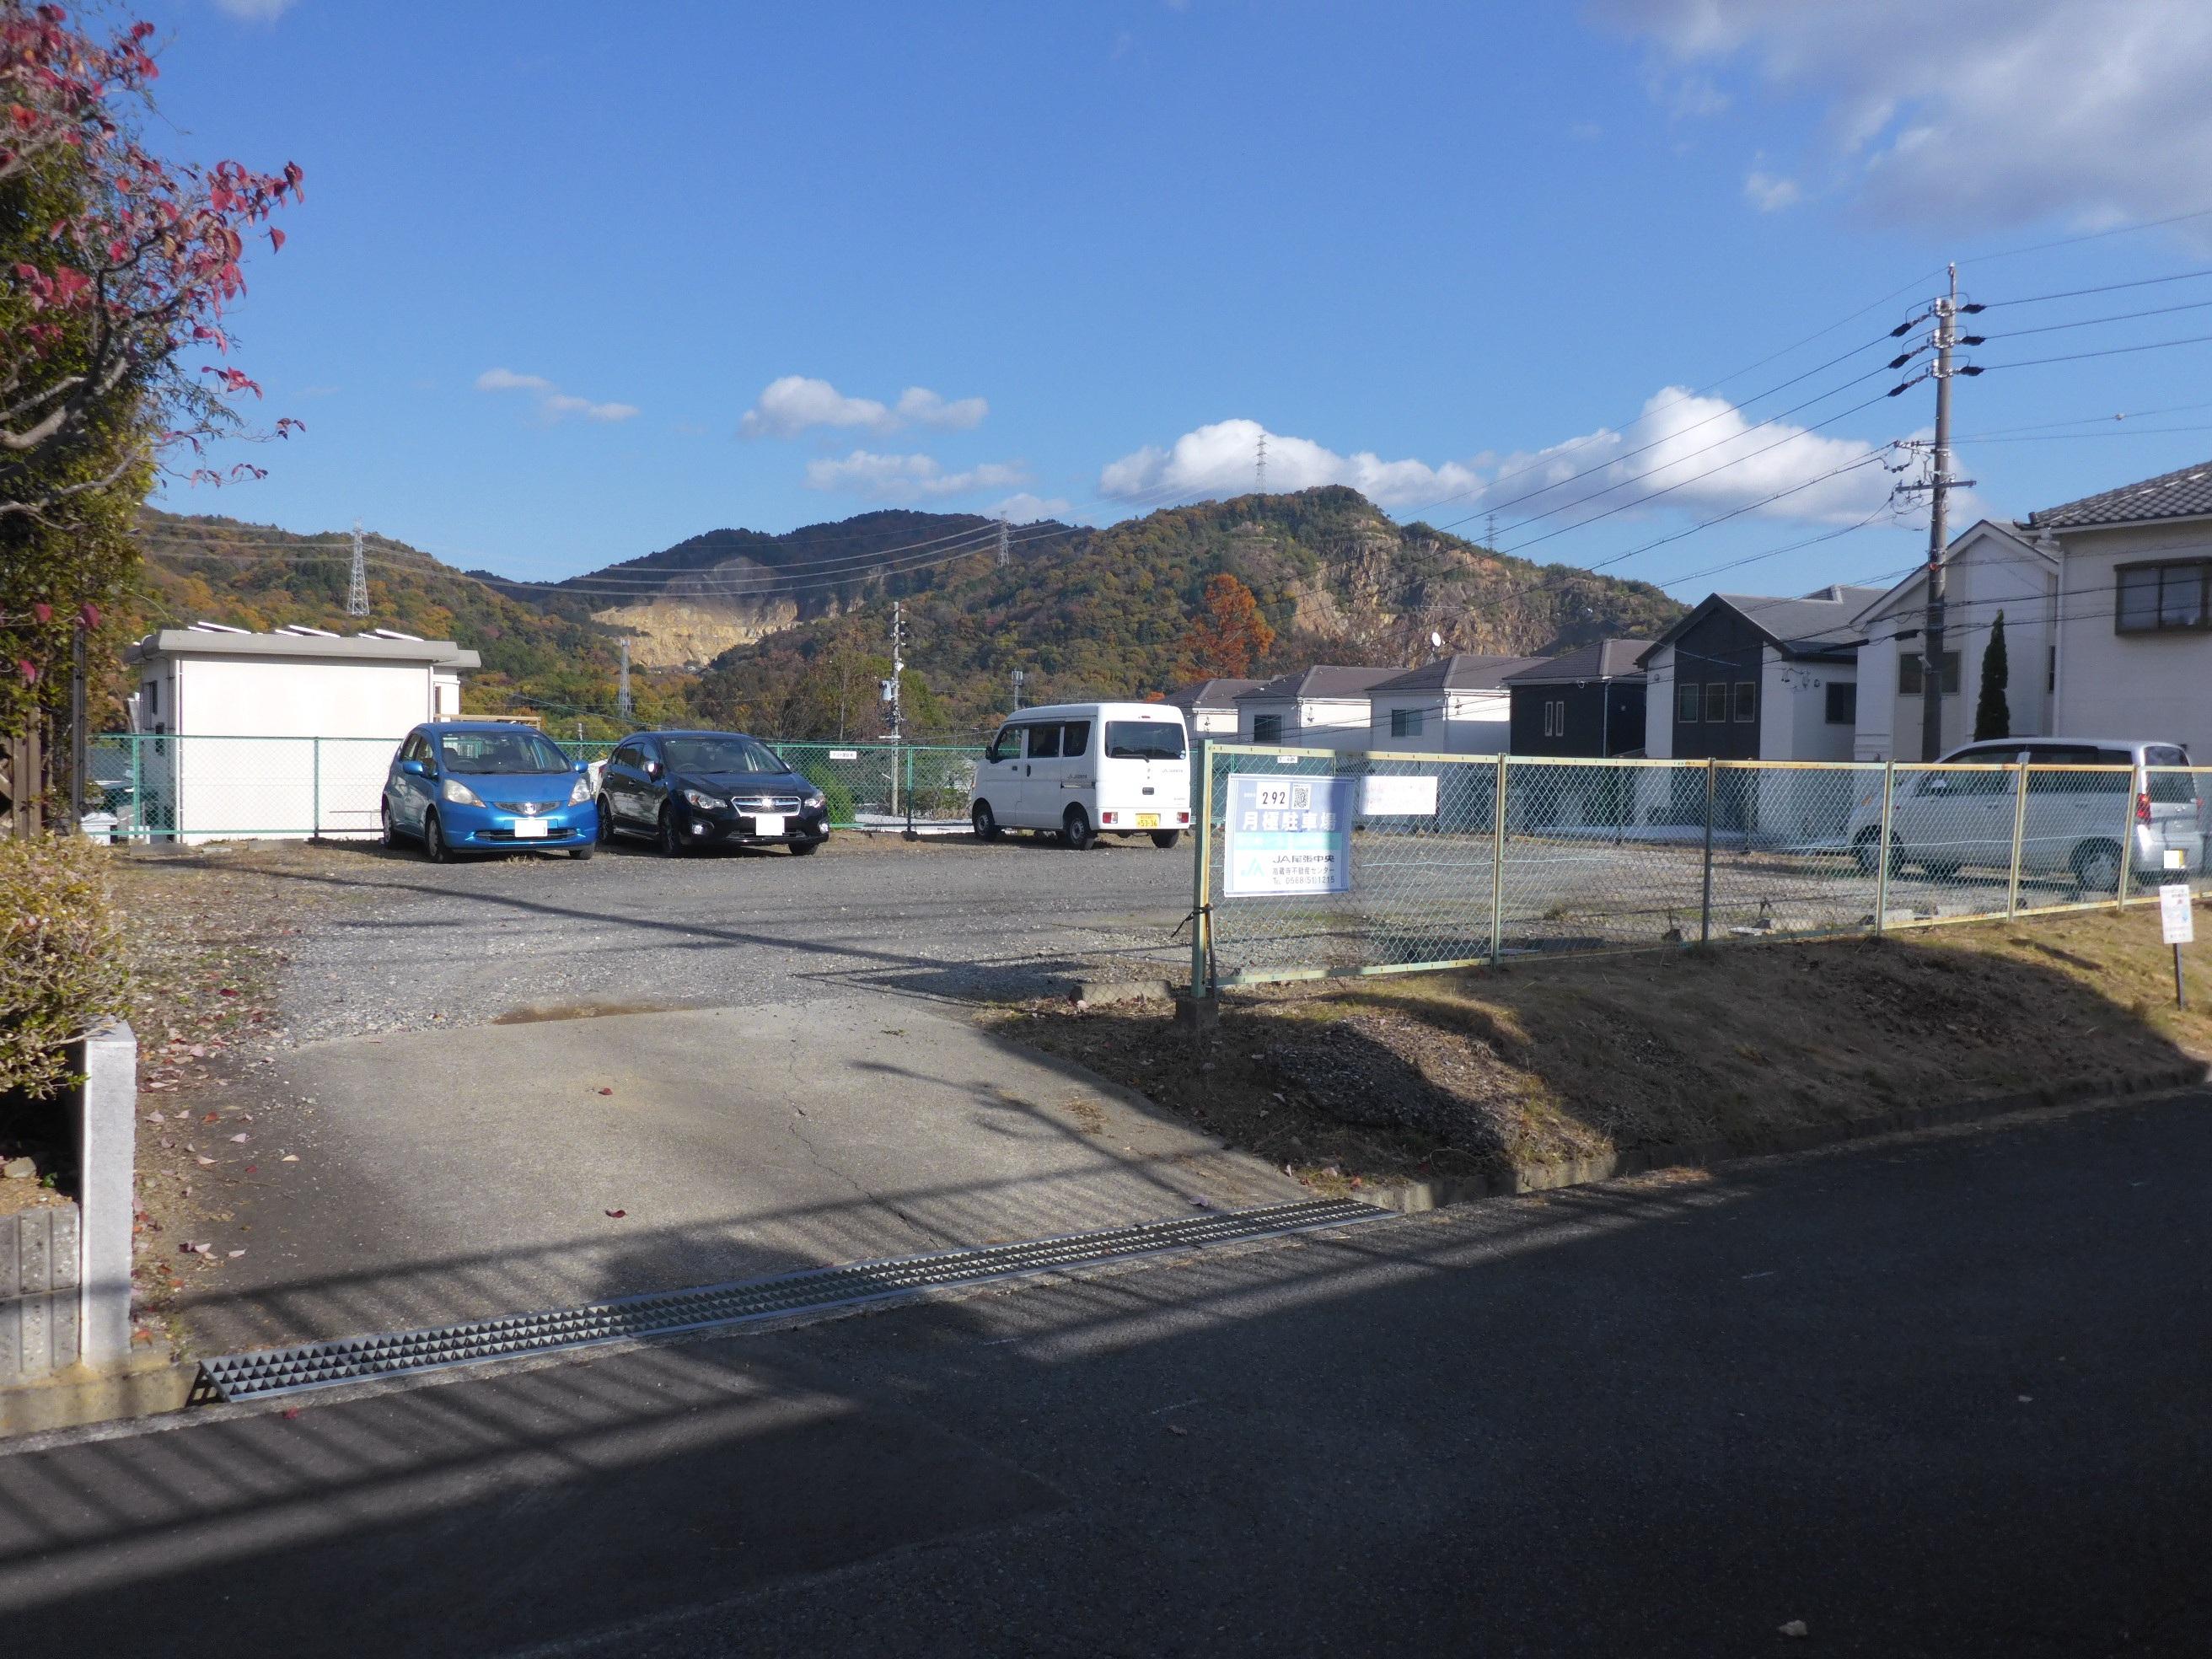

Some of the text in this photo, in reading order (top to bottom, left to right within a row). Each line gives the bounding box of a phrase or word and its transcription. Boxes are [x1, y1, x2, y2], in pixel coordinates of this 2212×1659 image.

[1262, 791, 1286, 805] 292
[1243, 810, 1336, 831] 月極駐車場
